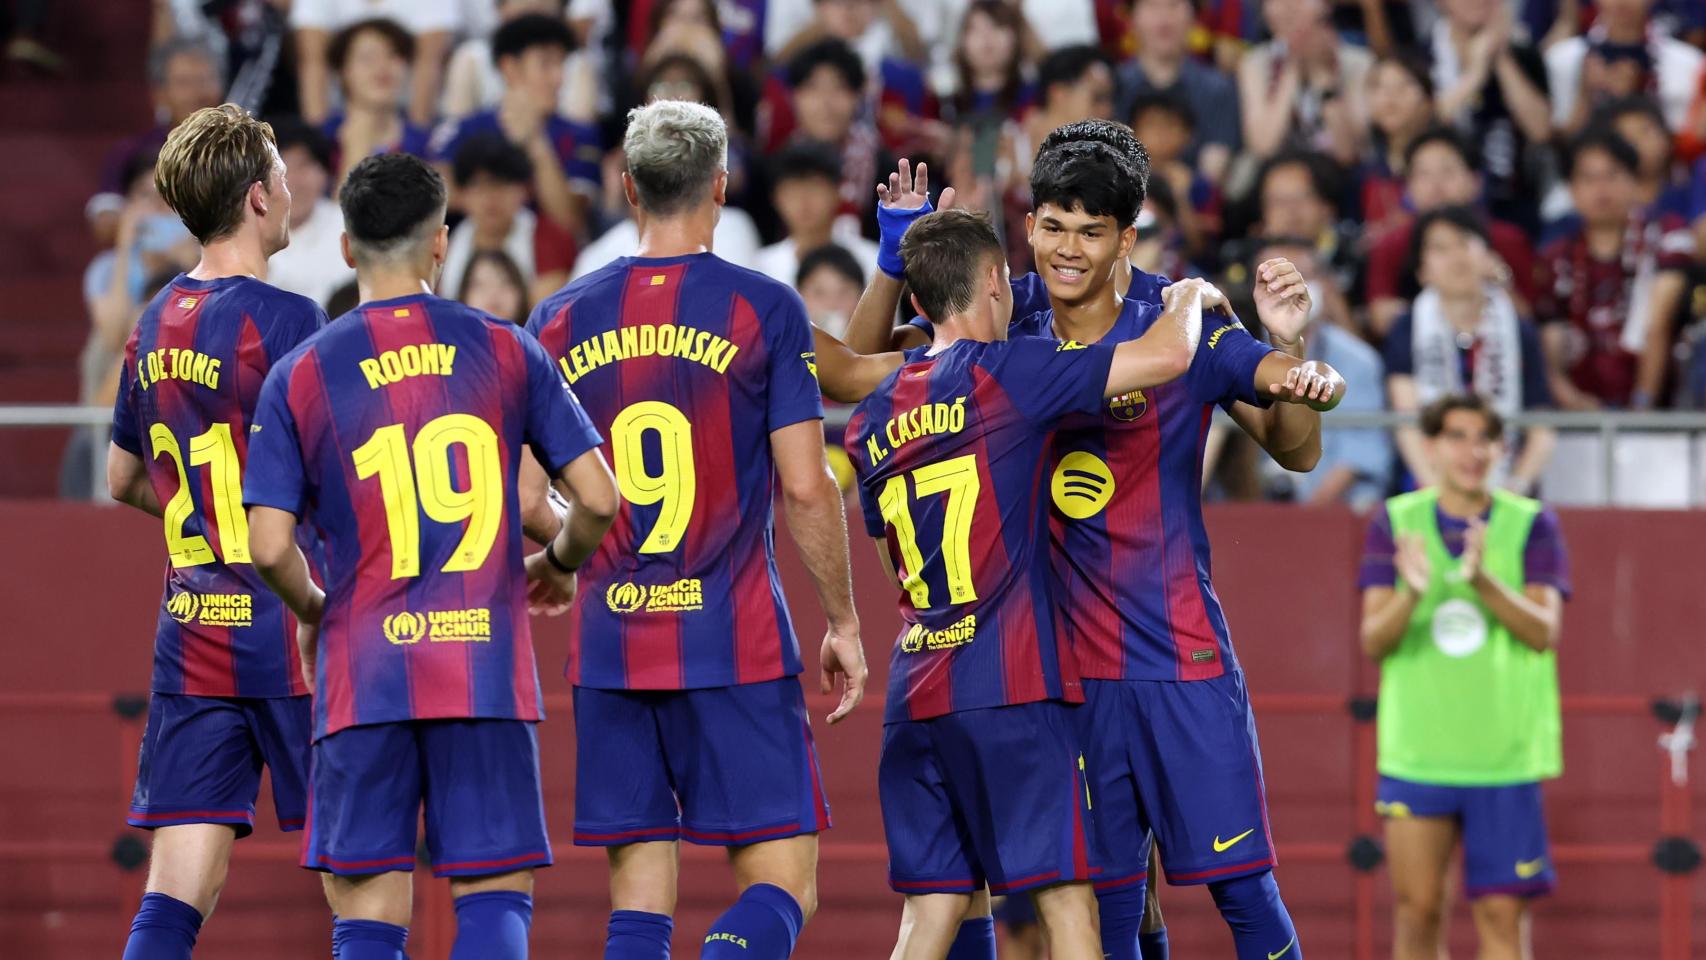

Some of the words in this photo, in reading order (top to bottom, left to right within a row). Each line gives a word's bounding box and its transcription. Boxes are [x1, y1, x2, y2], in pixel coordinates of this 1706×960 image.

[147, 348, 168, 383] DE
[169, 348, 221, 390] JONG
[358, 343, 457, 390] ROONY
[559, 324, 739, 385] LEWANDOWSKI
[866, 433, 888, 467] M.
[886, 396, 966, 449] CASADÓ
[149, 423, 254, 569] 21
[352, 414, 503, 580] 19
[610, 401, 696, 554] 9
[878, 454, 981, 609] 17
[199, 607, 252, 620] ACNUR
[200, 594, 252, 607] UNHCR
[428, 608, 490, 624] UNHCR
[646, 592, 703, 608] ACNUR
[428, 622, 491, 636] ACNUR
[927, 627, 975, 645] ACNUR
